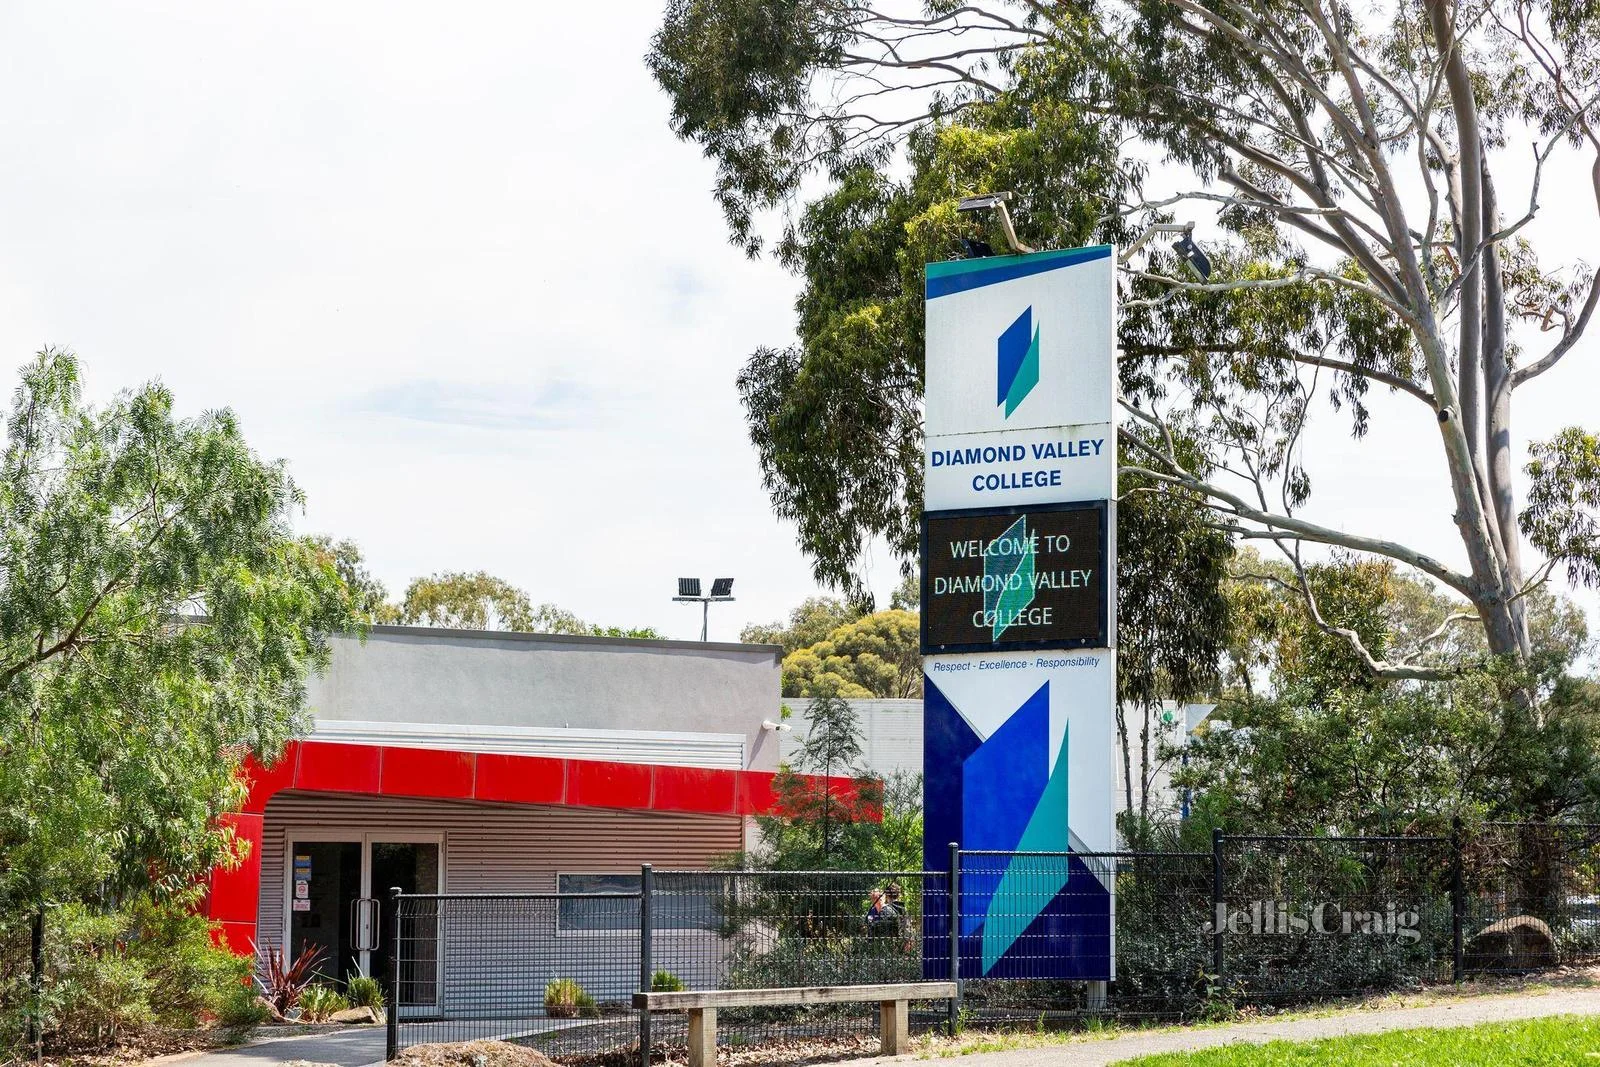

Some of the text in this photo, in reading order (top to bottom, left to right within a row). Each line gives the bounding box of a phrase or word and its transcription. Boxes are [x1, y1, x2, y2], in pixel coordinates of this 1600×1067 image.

[931, 439, 1104, 467] DIAMOND VALLEY
[972, 470, 1062, 491] COLLEGE
[950, 535, 1070, 558] WELCOME TO
[935, 570, 1092, 594] DIAMOND VALLEY
[972, 607, 1053, 628] COLLEGE
[934, 662, 970, 672] Respect
[979, 660, 1027, 671] Excellence
[1036, 657, 1100, 669] Responsibility
